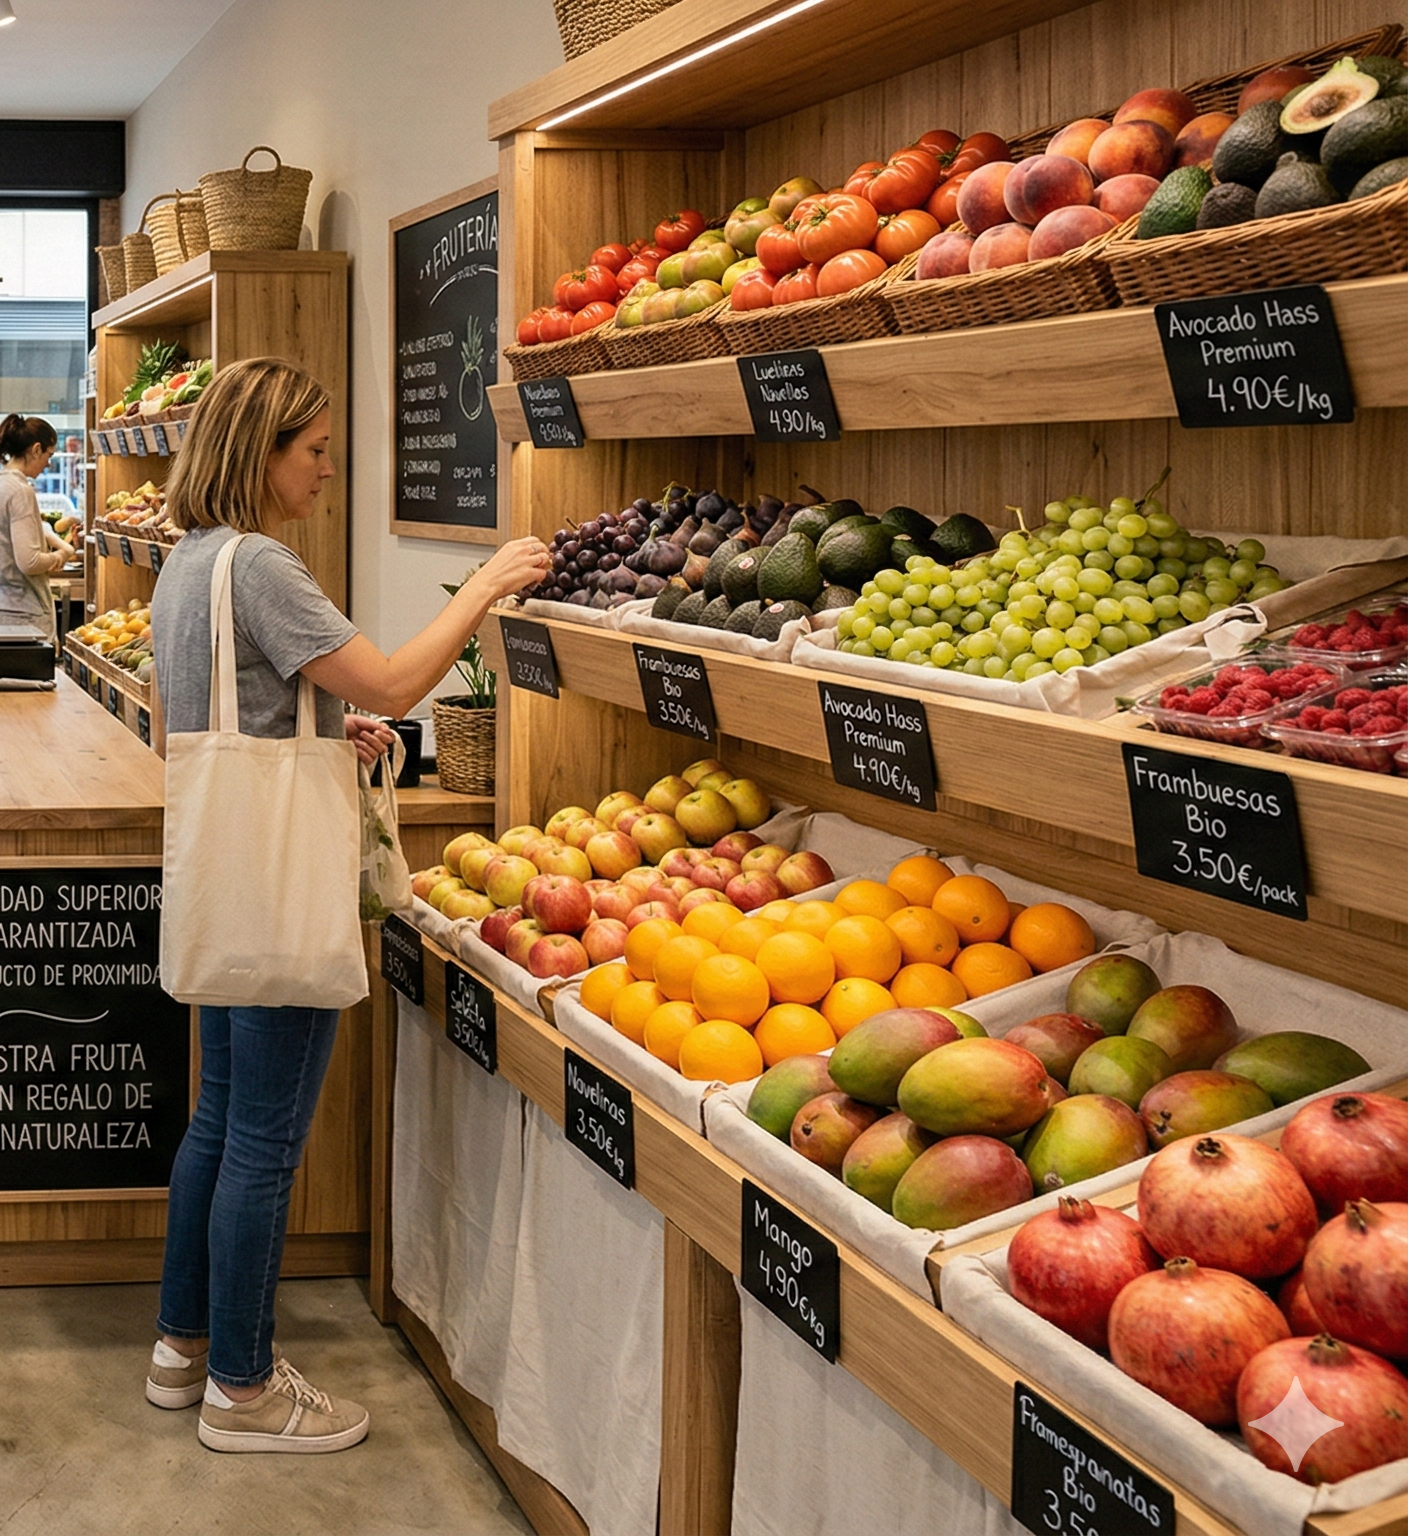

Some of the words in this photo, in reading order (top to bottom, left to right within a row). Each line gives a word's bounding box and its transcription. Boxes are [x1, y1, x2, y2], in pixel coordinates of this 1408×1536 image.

[433, 202, 498, 280] FRUTERÍA
[1169, 304, 1257, 338] Avocado
[1263, 300, 1320, 328] Hass
[1200, 337, 1297, 366] Premium
[1207, 374, 1334, 420] 4.90€/kg
[662, 676, 682, 698] Bio
[824, 689, 882, 724] Avocado
[885, 703, 922, 733] Hass
[844, 720, 906, 756] Premium
[1133, 756, 1282, 816] Frambuesas
[1185, 804, 1227, 838] Bio
[1172, 840, 1300, 907] 3,50€/pack
[57, 884, 163, 912] SUPERIOR
[44, 963, 65, 986] DE
[71, 1043, 147, 1072] FRUTA
[27, 1083, 112, 1111] REGALO
[125, 1082, 153, 1110] DE
[1, 1122, 151, 1150] NATURALEZA
[755, 1199, 813, 1274] Mango
[1063, 1465, 1097, 1513] Bio
